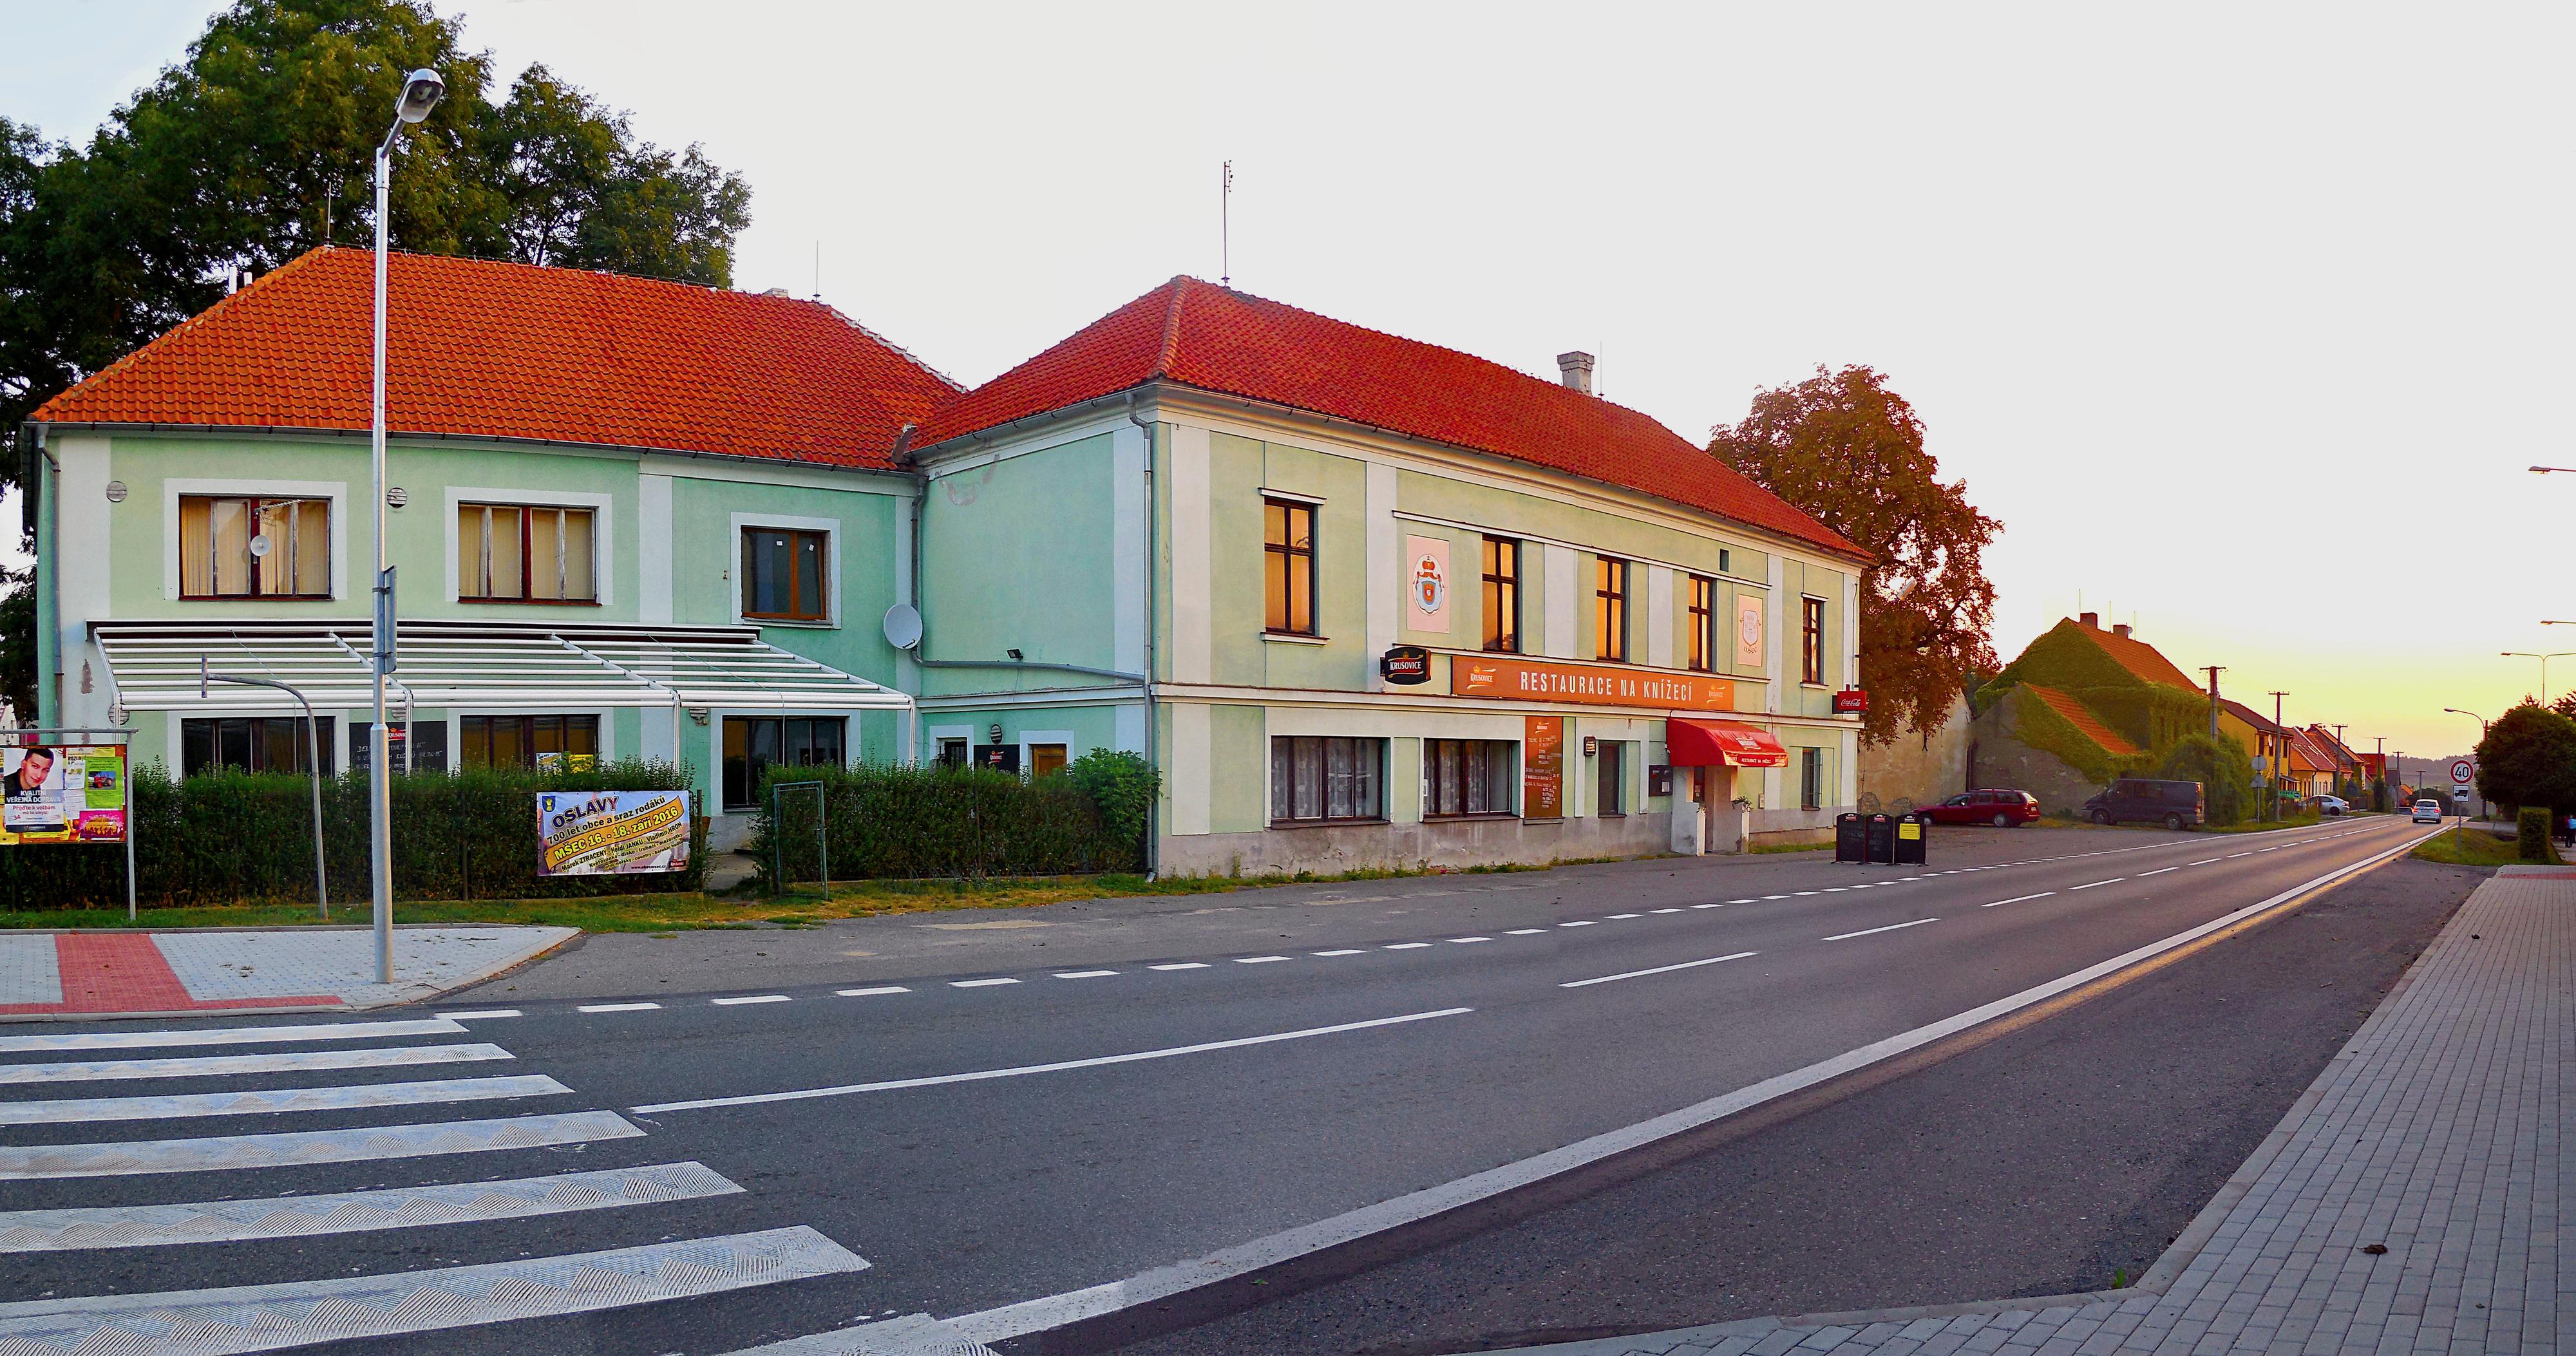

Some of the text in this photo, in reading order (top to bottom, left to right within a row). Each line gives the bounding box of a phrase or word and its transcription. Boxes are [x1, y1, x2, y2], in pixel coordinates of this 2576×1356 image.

[1390, 661, 1422, 670] KRUŠOVICE
[1520, 671, 1692, 701] RESTAURACE NA KNÍŽECÍ
[2455, 766, 2469, 778] 40
[547, 832, 565, 845] 700
[567, 825, 580, 836] let
[582, 820, 604, 831] obce
[614, 810, 634, 822] sraz
[634, 795, 666, 814] rodáků
[553, 796, 619, 829] OSLAVY
[554, 840, 587, 861] MŠEC
[588, 833, 605, 847] 16.
[612, 825, 630, 839] 18.
[631, 816, 652, 834] září
[652, 806, 678, 825] 2016
[562, 860, 580, 871] Marek
[580, 847, 607, 863] ZTRACENÝ
[611, 844, 625, 854] Heidi
[668, 822, 683, 834] HRON
